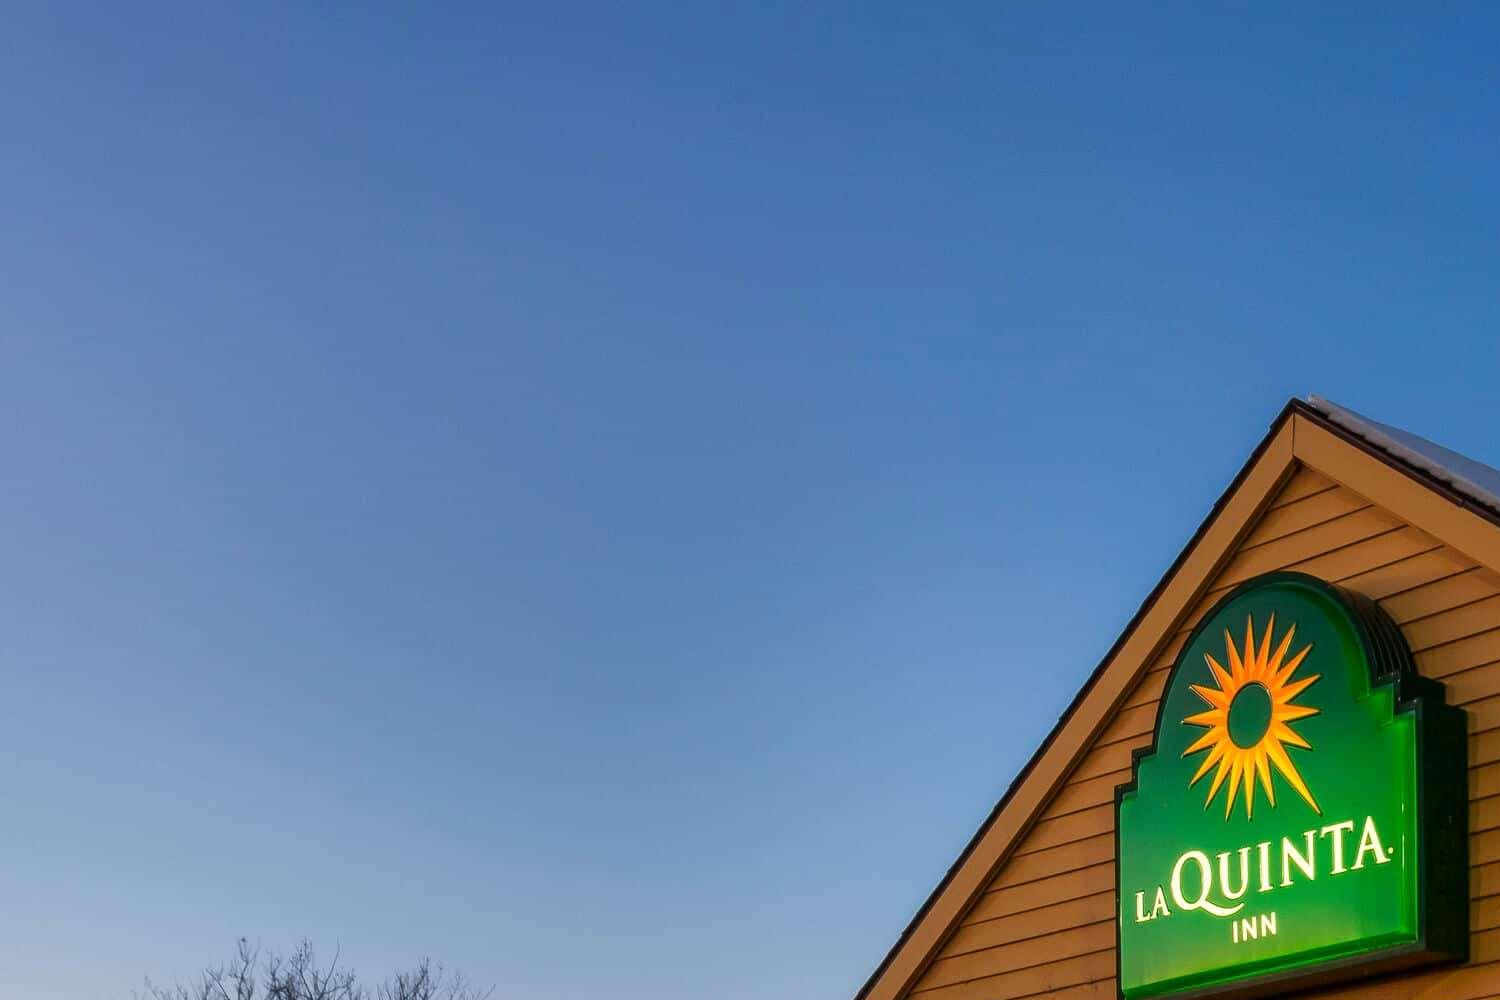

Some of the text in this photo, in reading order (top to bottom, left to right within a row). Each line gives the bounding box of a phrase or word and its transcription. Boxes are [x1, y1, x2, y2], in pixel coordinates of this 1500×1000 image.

[1135, 815, 1392, 923] LA QUINTA
[1232, 911, 1277, 943] INN
